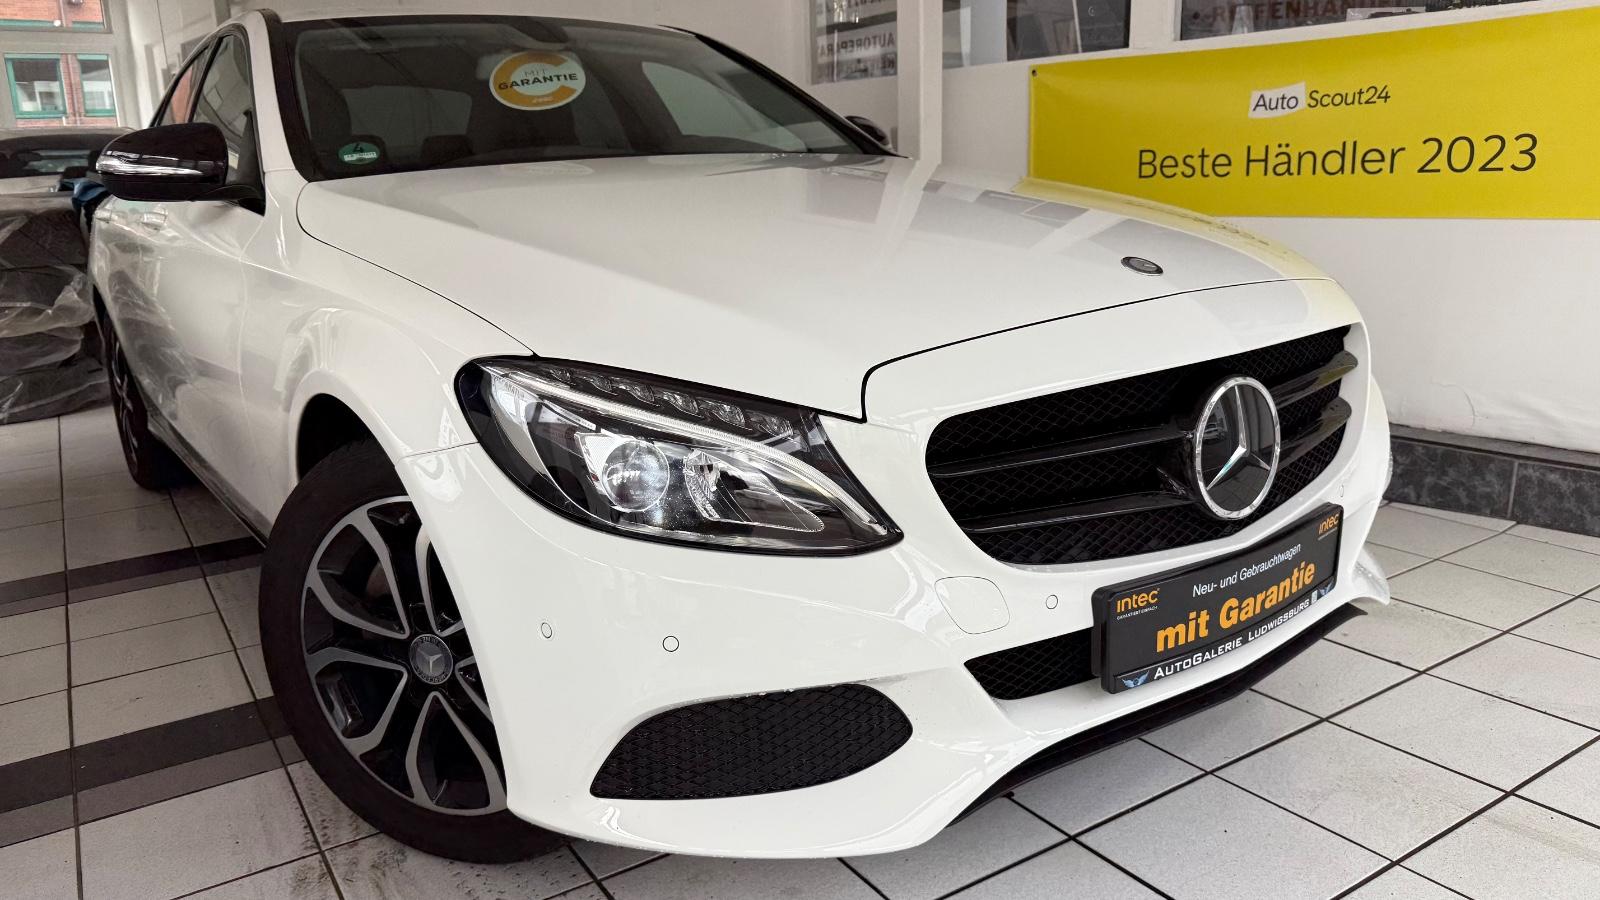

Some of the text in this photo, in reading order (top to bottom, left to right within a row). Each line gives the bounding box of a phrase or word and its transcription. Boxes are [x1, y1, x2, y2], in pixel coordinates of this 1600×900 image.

[498, 73, 579, 90] GARANTIE
[1252, 85, 1391, 111] Auto Scout24
[1138, 133, 1538, 179] Beste Händler 2023
[1192, 543, 1301, 598] Neu- und Gebrauchtwagen
[1116, 590, 1158, 613] intec
[1156, 561, 1315, 652] mit Garantie
